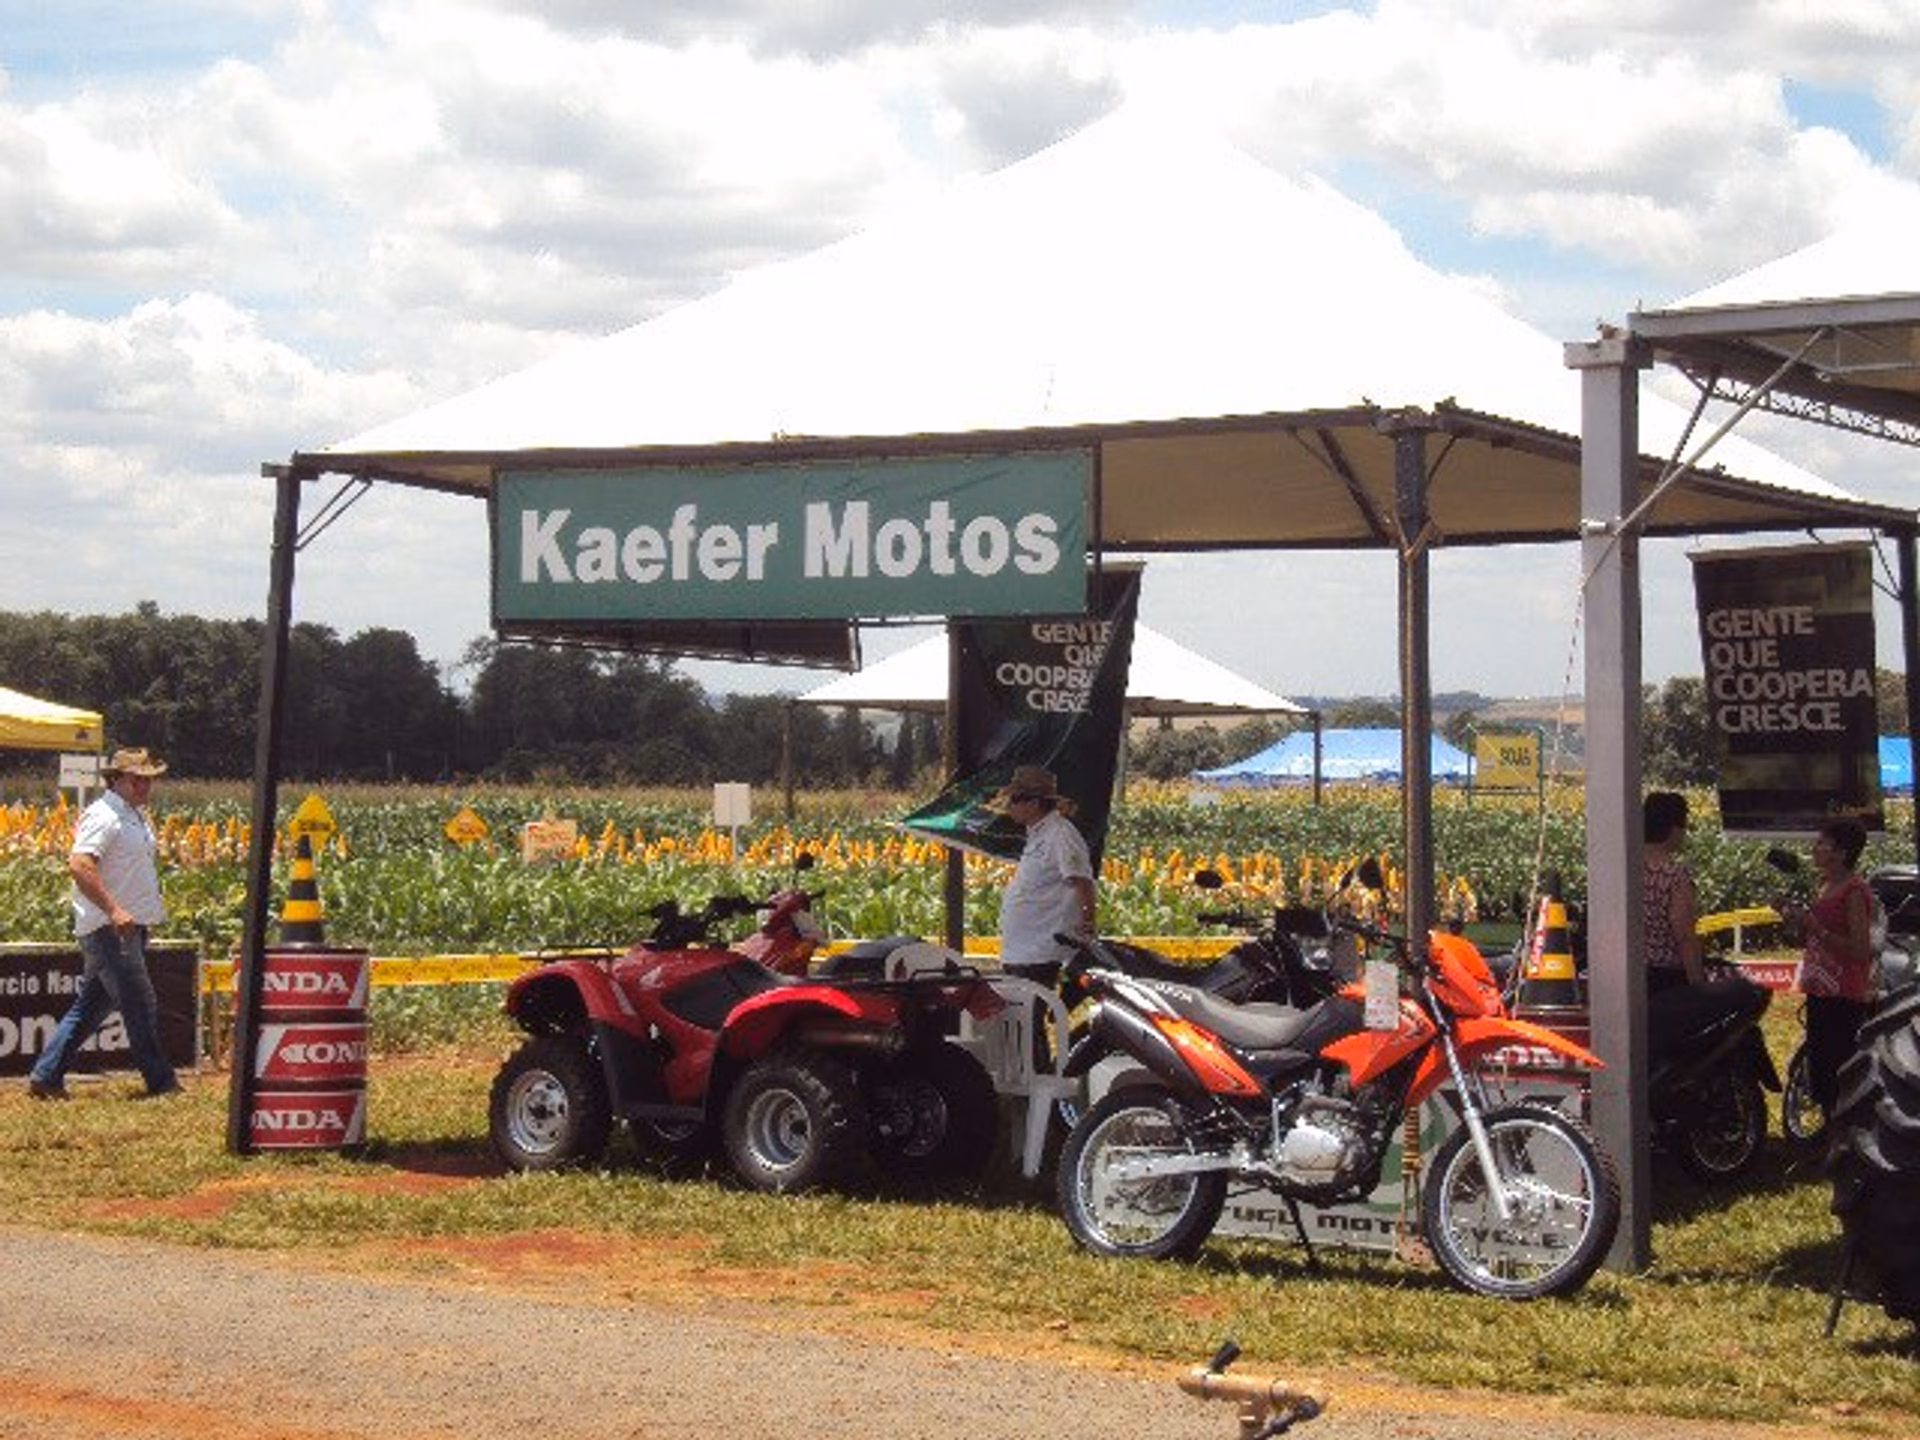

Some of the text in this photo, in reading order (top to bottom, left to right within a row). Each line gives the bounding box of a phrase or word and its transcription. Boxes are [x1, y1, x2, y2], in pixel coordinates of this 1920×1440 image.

[520, 501, 1060, 583] Kaefer Motos
[1707, 606, 1815, 638] GENTE
[1710, 639, 1780, 671] QUE
[1713, 668, 1874, 701] COOPERA
[47, 970, 87, 996] Nac
[261, 972, 350, 994] NDA
[254, 1110, 346, 1130] NDA
